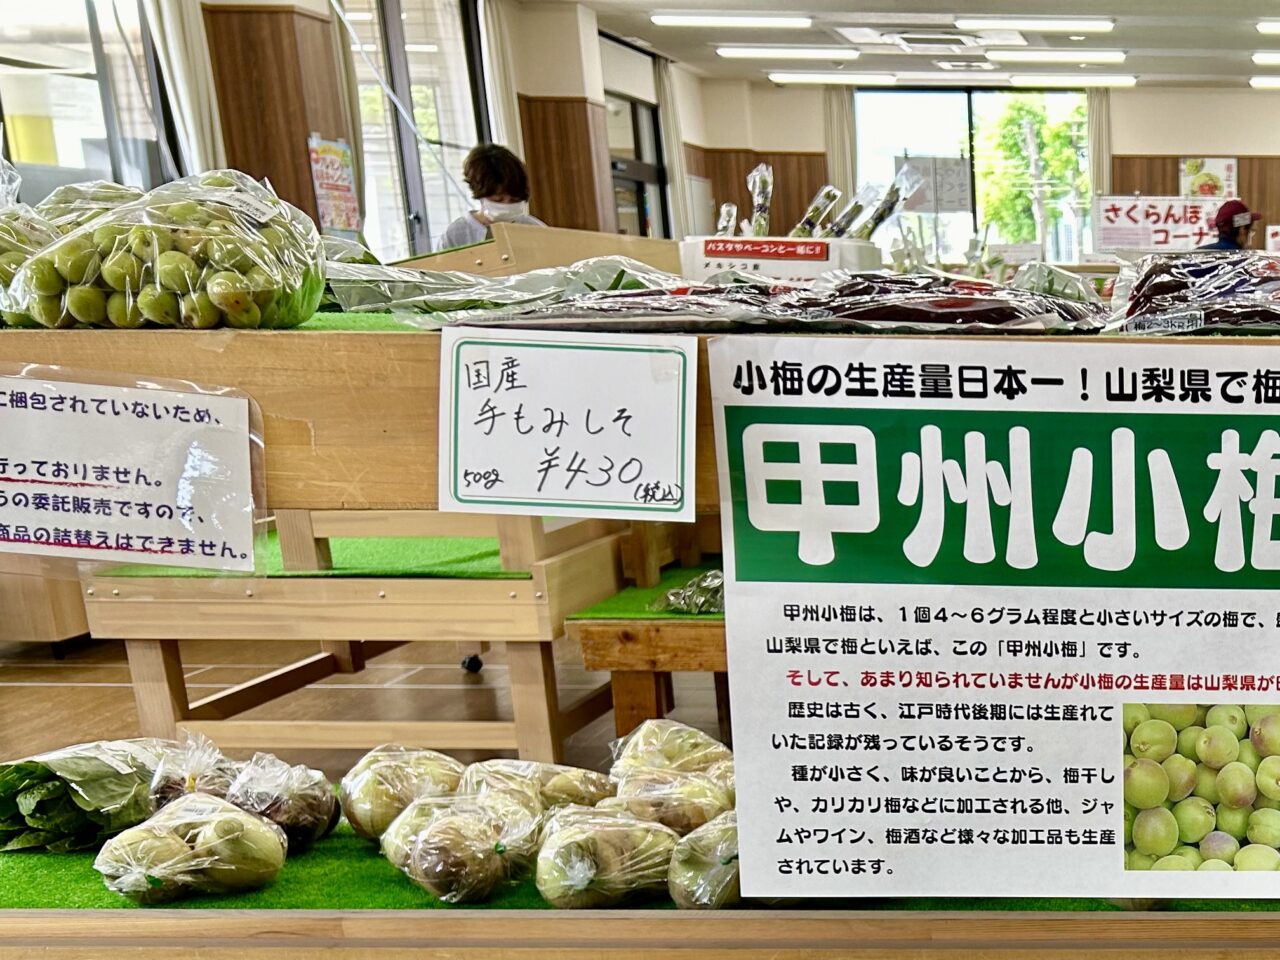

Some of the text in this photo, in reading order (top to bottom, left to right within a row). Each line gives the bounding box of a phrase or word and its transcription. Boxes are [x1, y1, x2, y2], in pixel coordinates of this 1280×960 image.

[466, 357, 527, 392] 国産
[474, 398, 633, 437] 手もみしそ
[464, 469, 504, 490] 500g
[537, 446, 643, 492] ¥430
[766, 636, 1140, 659] 山梨県で梅といえば、この「甲州小梅」です。
[788, 701, 1114, 722] 歴史は古く、江戸時代後期には生産れて
[771, 733, 1034, 753] いた記録が残っているそうです。
[791, 765, 1115, 784] 種が小さく、味が良いことから、梅干し
[774, 796, 1114, 815] や、カリカリ梅などに加工される他、ジャ
[776, 828, 1116, 845] ムやワイン、梅酒など様々な加工品も生産
[777, 858, 893, 875] されています。
